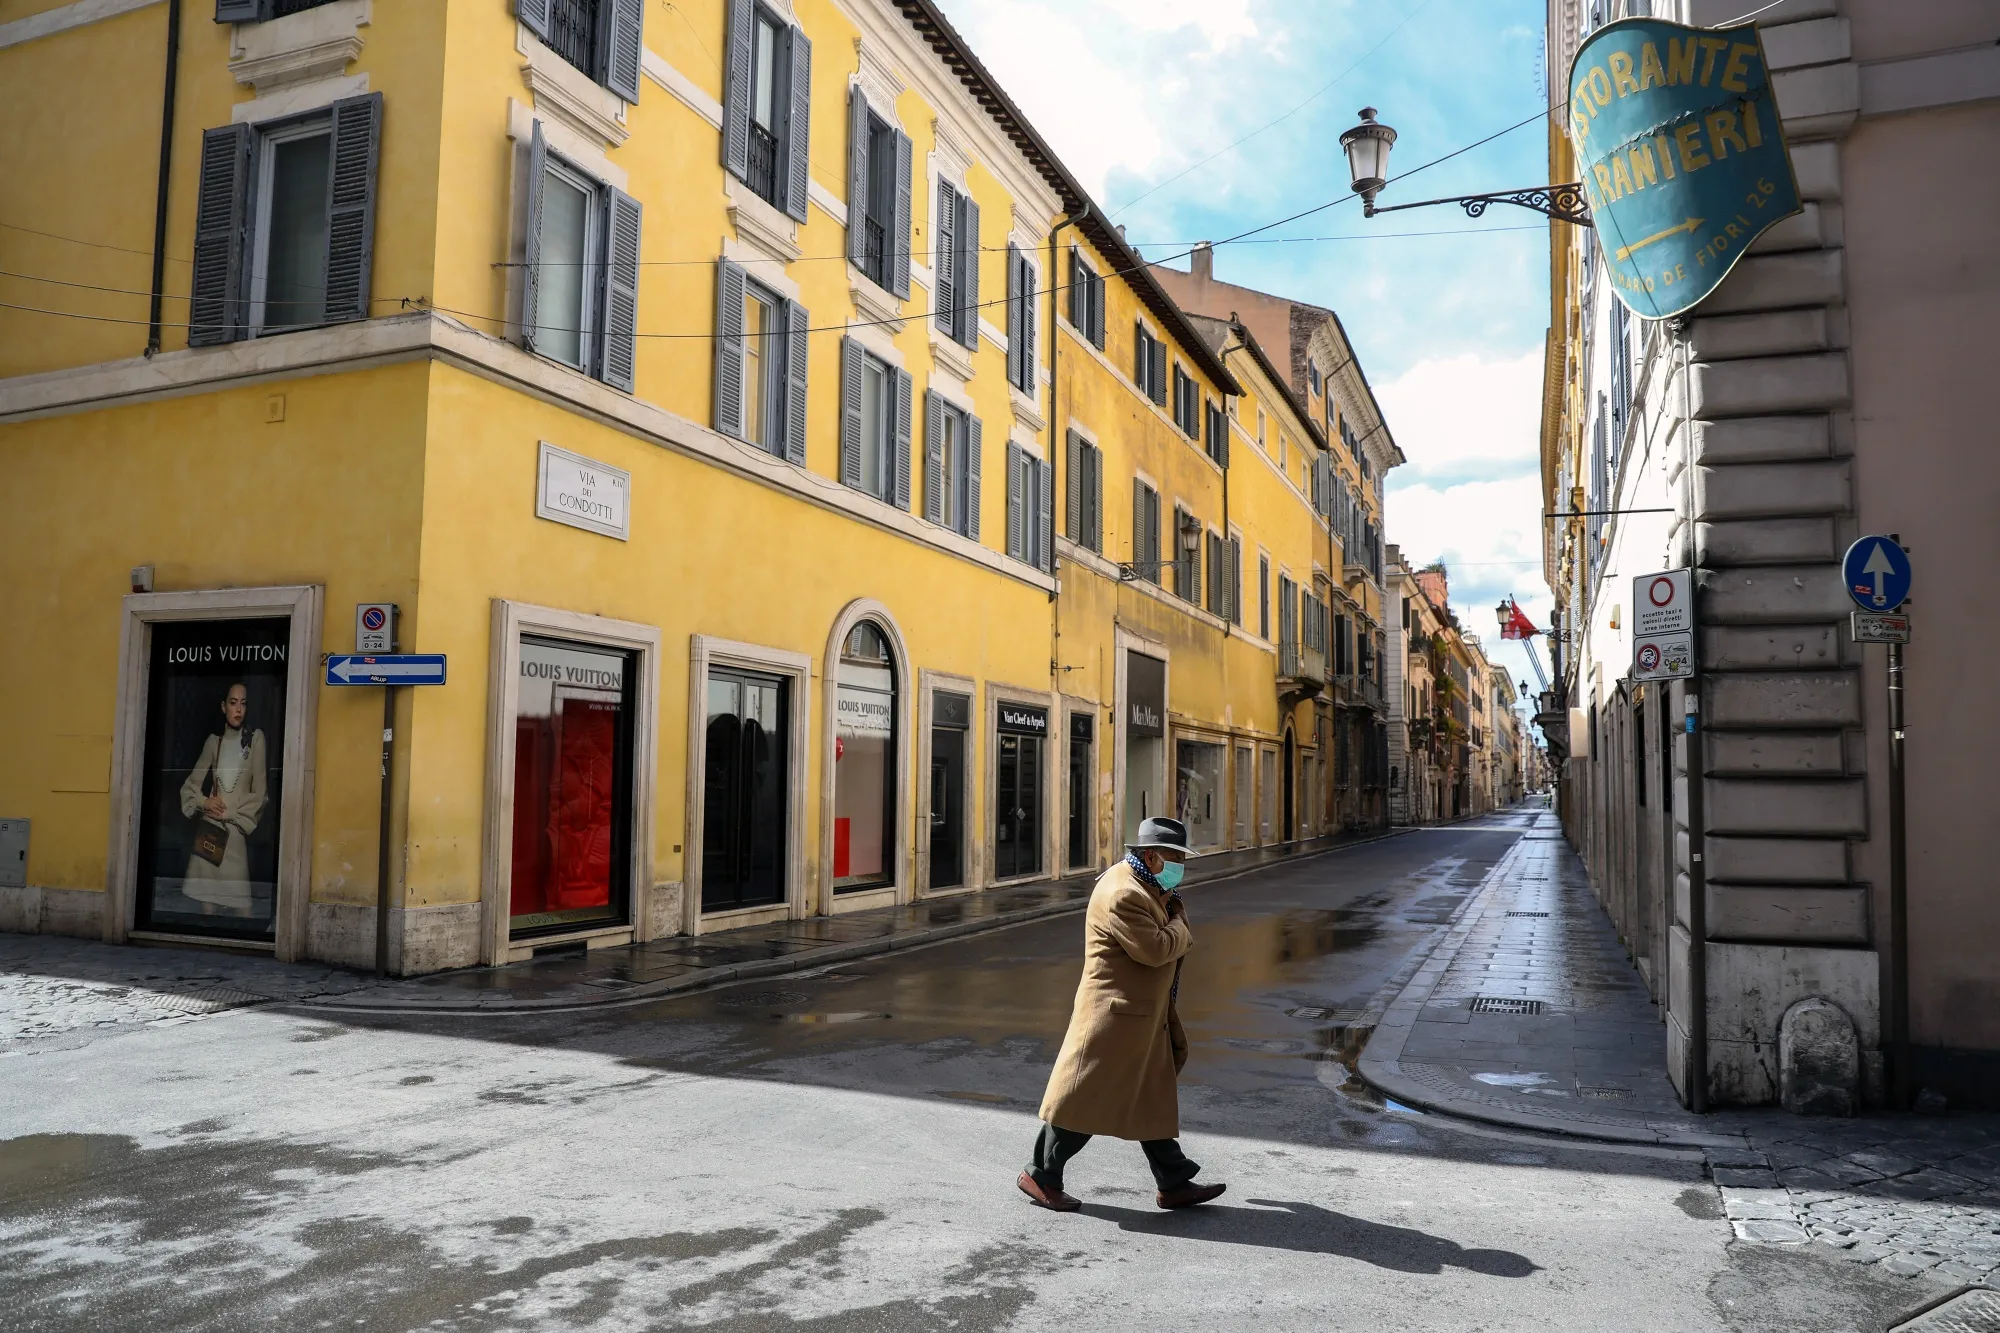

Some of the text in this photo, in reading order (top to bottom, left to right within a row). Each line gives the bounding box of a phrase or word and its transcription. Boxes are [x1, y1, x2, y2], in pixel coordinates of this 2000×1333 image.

[1594, 100, 1763, 205] RANIERI
[1663, 263, 1686, 286] DE
[1695, 214, 1750, 267] FIORI
[1746, 176, 1775, 208] 26
[579, 470, 596, 487] VIA
[582, 487, 592, 498] DEI
[559, 492, 612, 520] CONDOTTI
[168, 644, 285, 663] LOUIS VUITTON
[520, 660, 621, 687] LOUIS VUITTON
[838, 700, 890, 716] LOUIS VUITTON
[1003, 710, 1013, 723] Van
[1013, 712, 1027, 725] Cleef
[1030, 714, 1045, 730] Arpels
